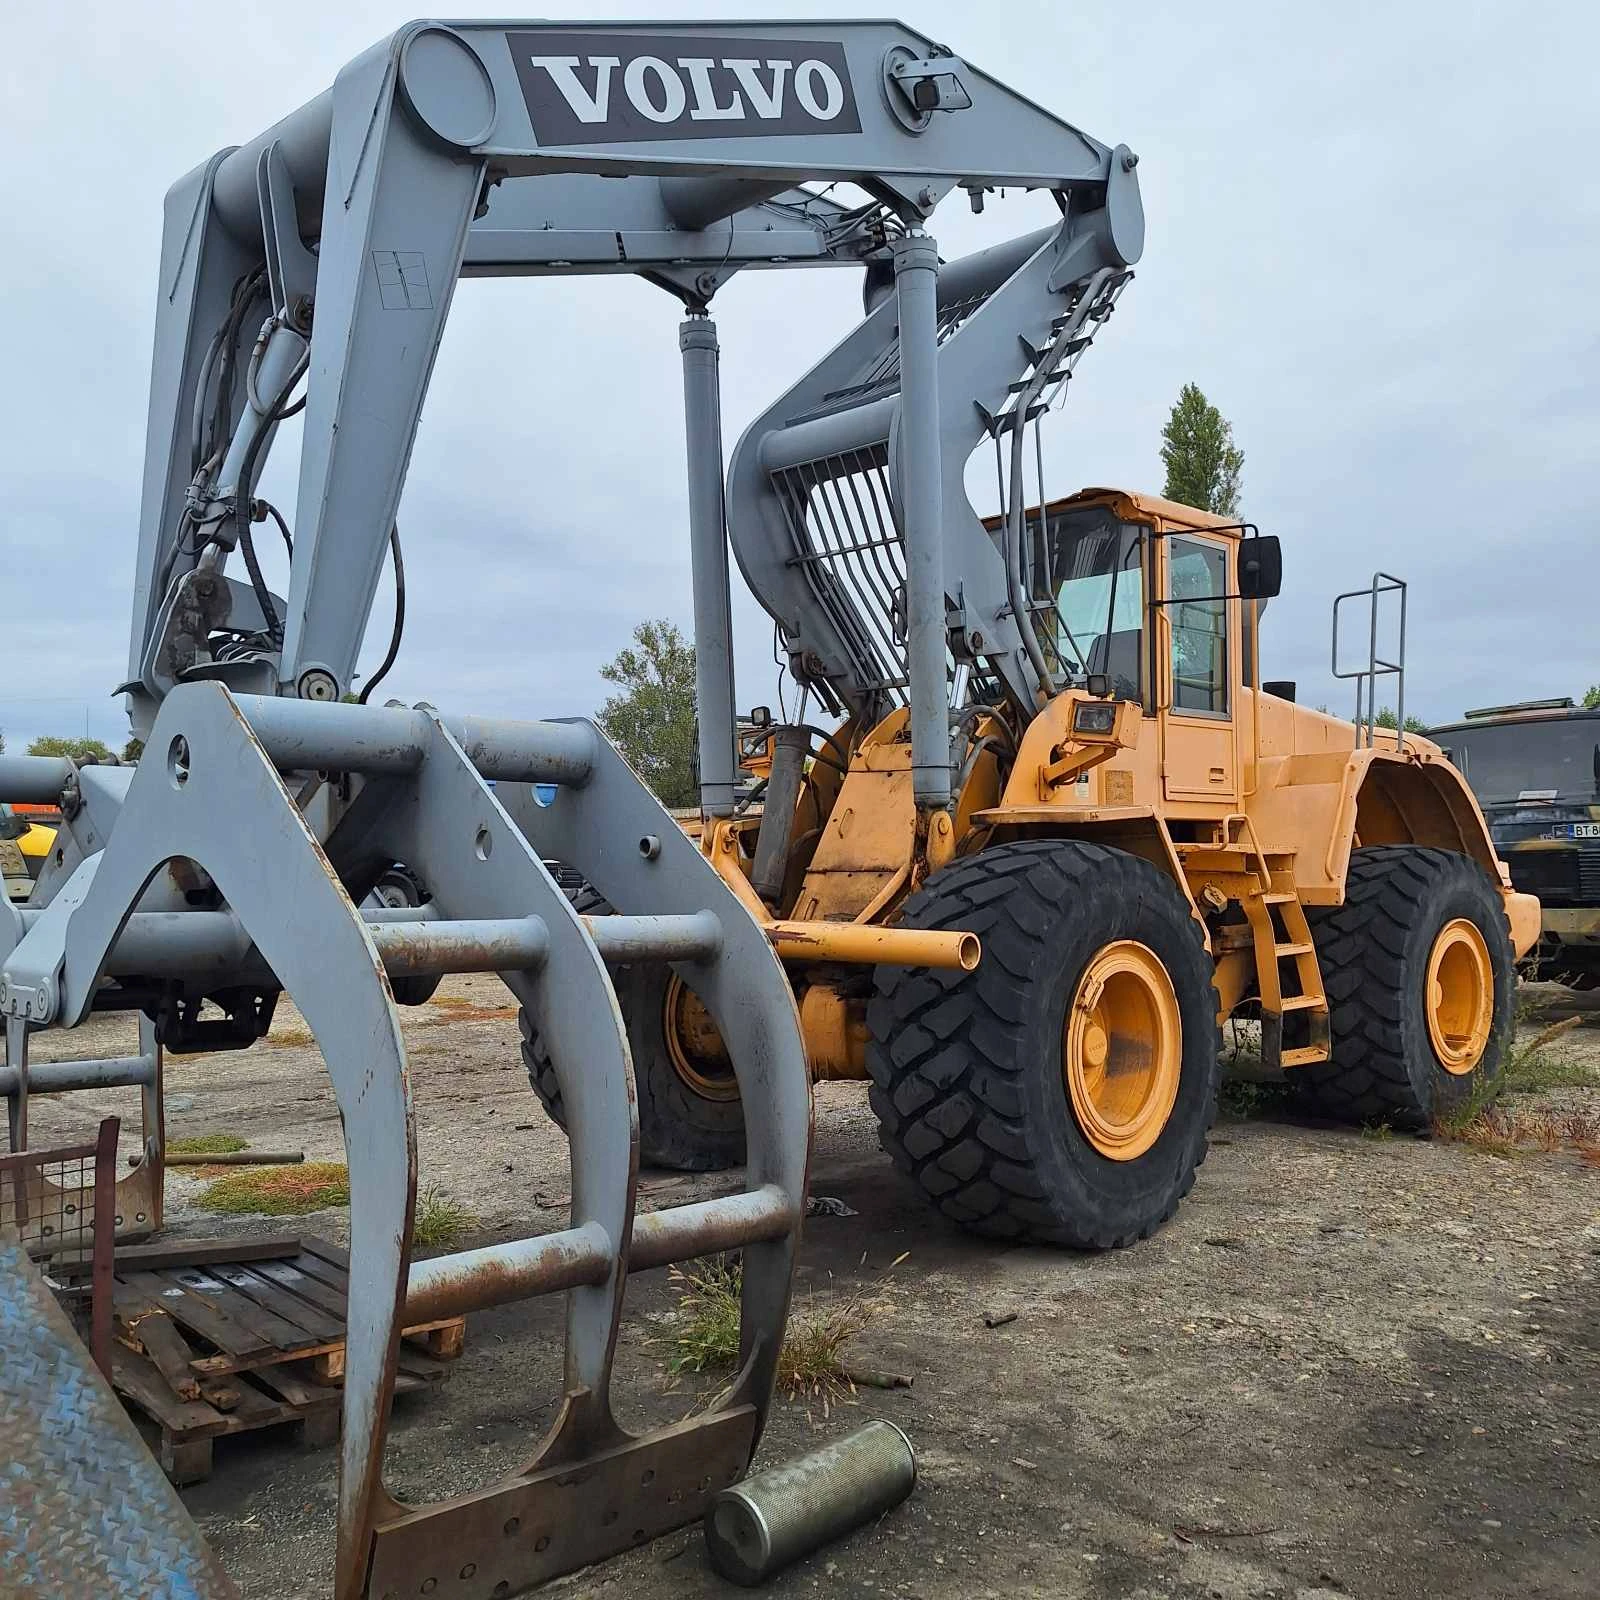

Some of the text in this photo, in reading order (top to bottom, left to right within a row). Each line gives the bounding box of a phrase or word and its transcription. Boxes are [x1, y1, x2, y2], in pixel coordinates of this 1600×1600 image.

[531, 55, 844, 124] VOLVO
[1576, 825, 1600, 836] BT 8
